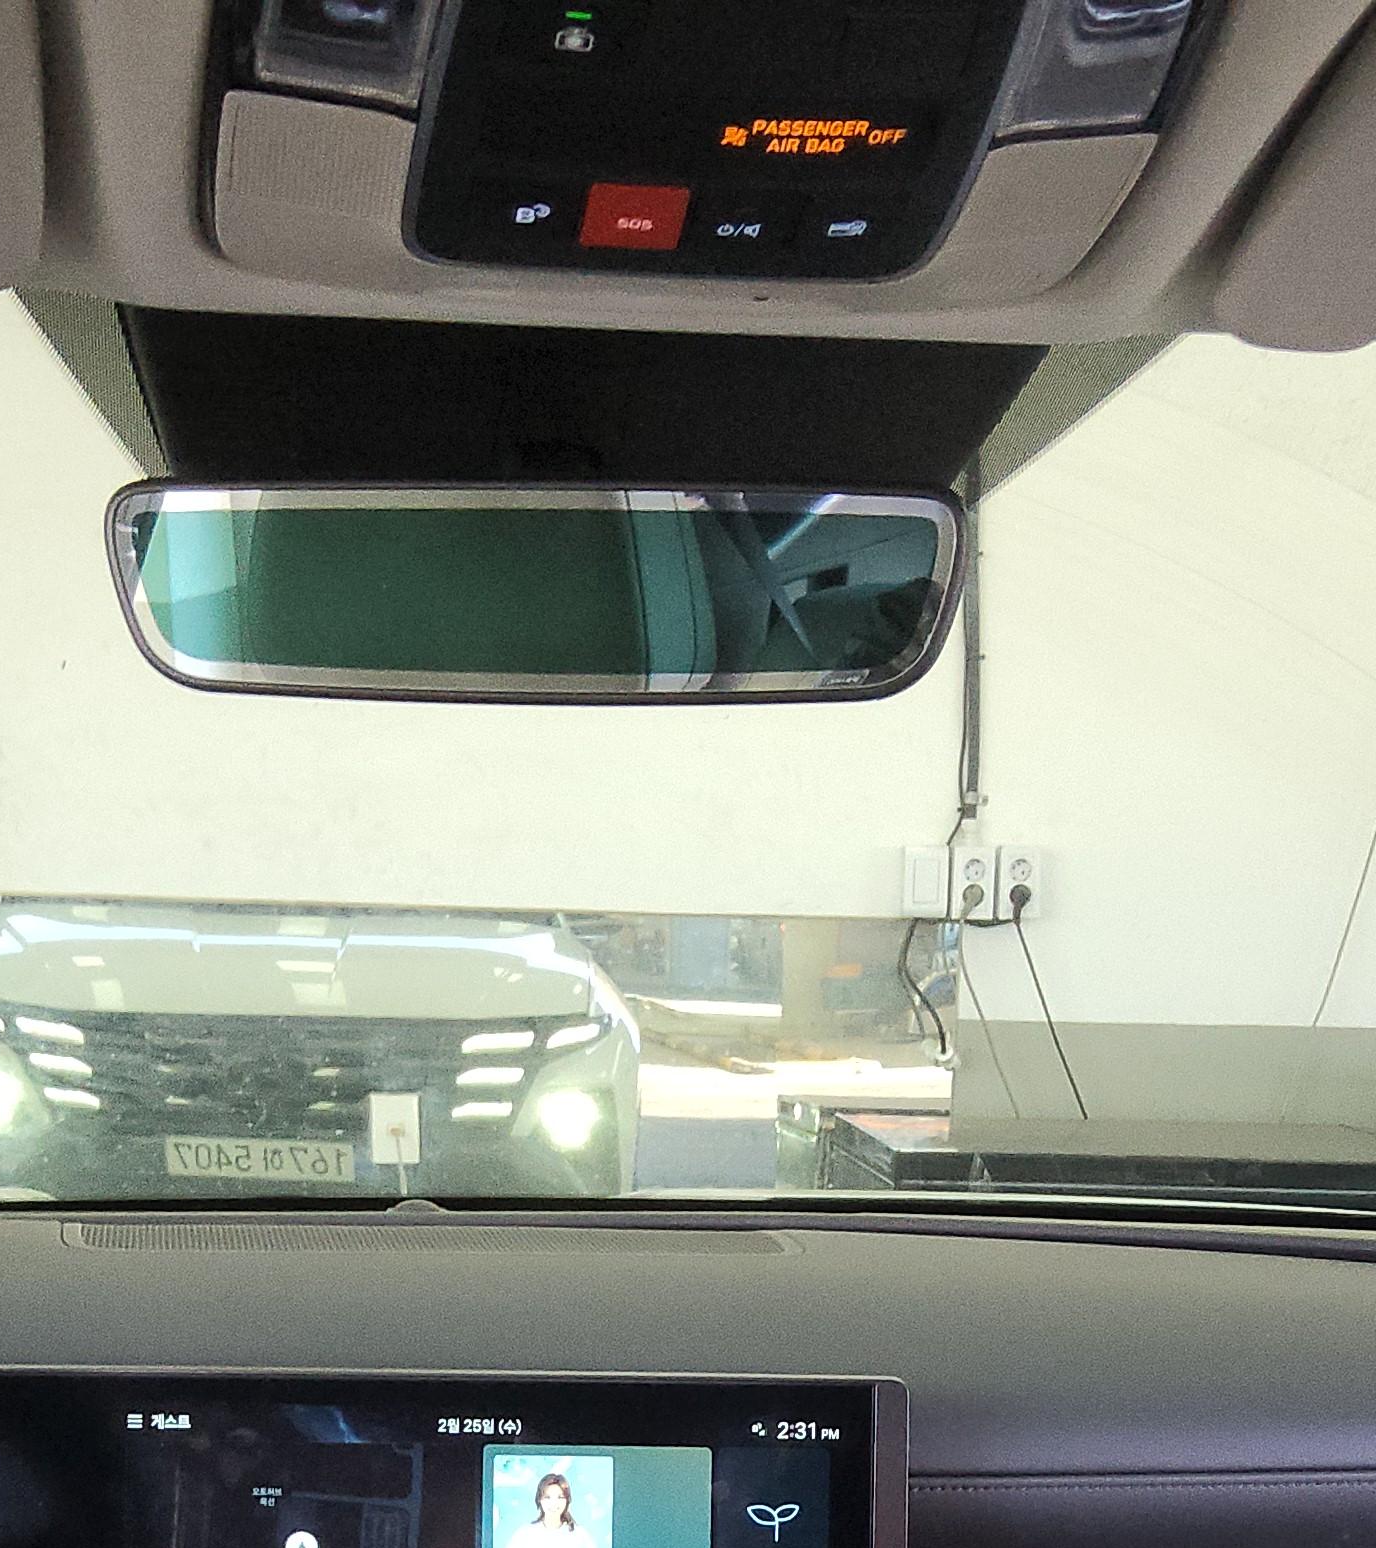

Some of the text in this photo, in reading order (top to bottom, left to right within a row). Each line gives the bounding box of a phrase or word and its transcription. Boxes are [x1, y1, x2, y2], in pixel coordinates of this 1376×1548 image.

[752, 119, 907, 145] PASSENGER OFF
[765, 138, 845, 153] AIR BAG
[617, 217, 653, 232] SOS
[150, 1413, 192, 1430] 게스트
[437, 1417, 522, 1436] 2월 25일 (수)
[776, 1421, 840, 1440] 2:31 PM
